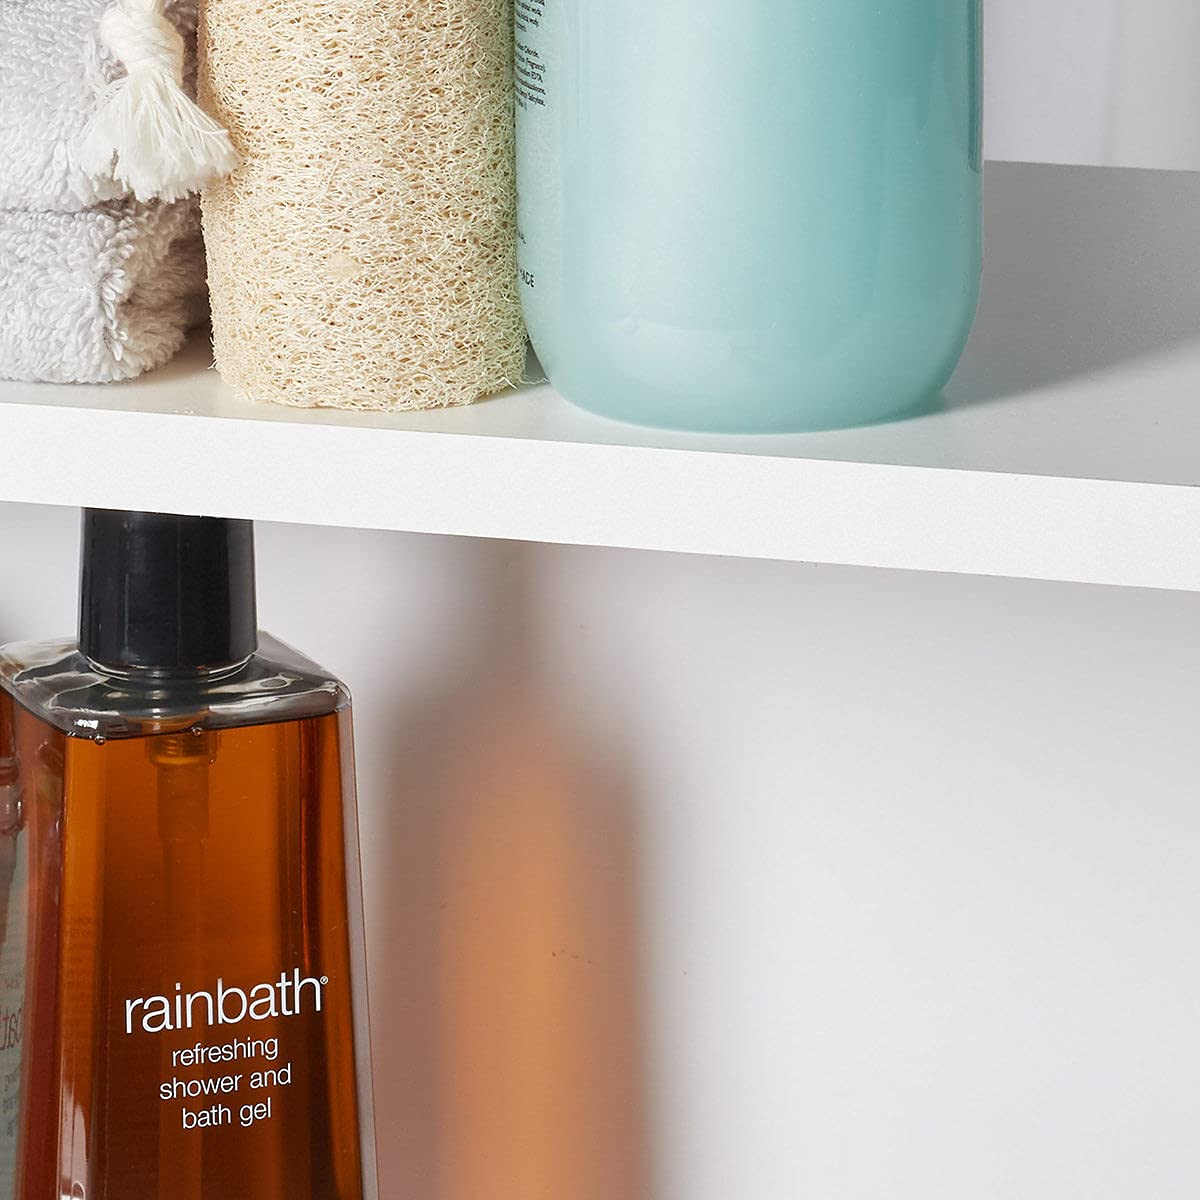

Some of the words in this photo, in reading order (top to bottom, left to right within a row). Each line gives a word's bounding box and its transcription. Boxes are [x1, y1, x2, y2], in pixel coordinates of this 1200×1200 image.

[172, 1036, 279, 1067] refreshing
[159, 1076, 243, 1100] shower
[249, 1062, 292, 1090] and
[182, 1103, 232, 1129] bath
[239, 1096, 272, 1127] gel
